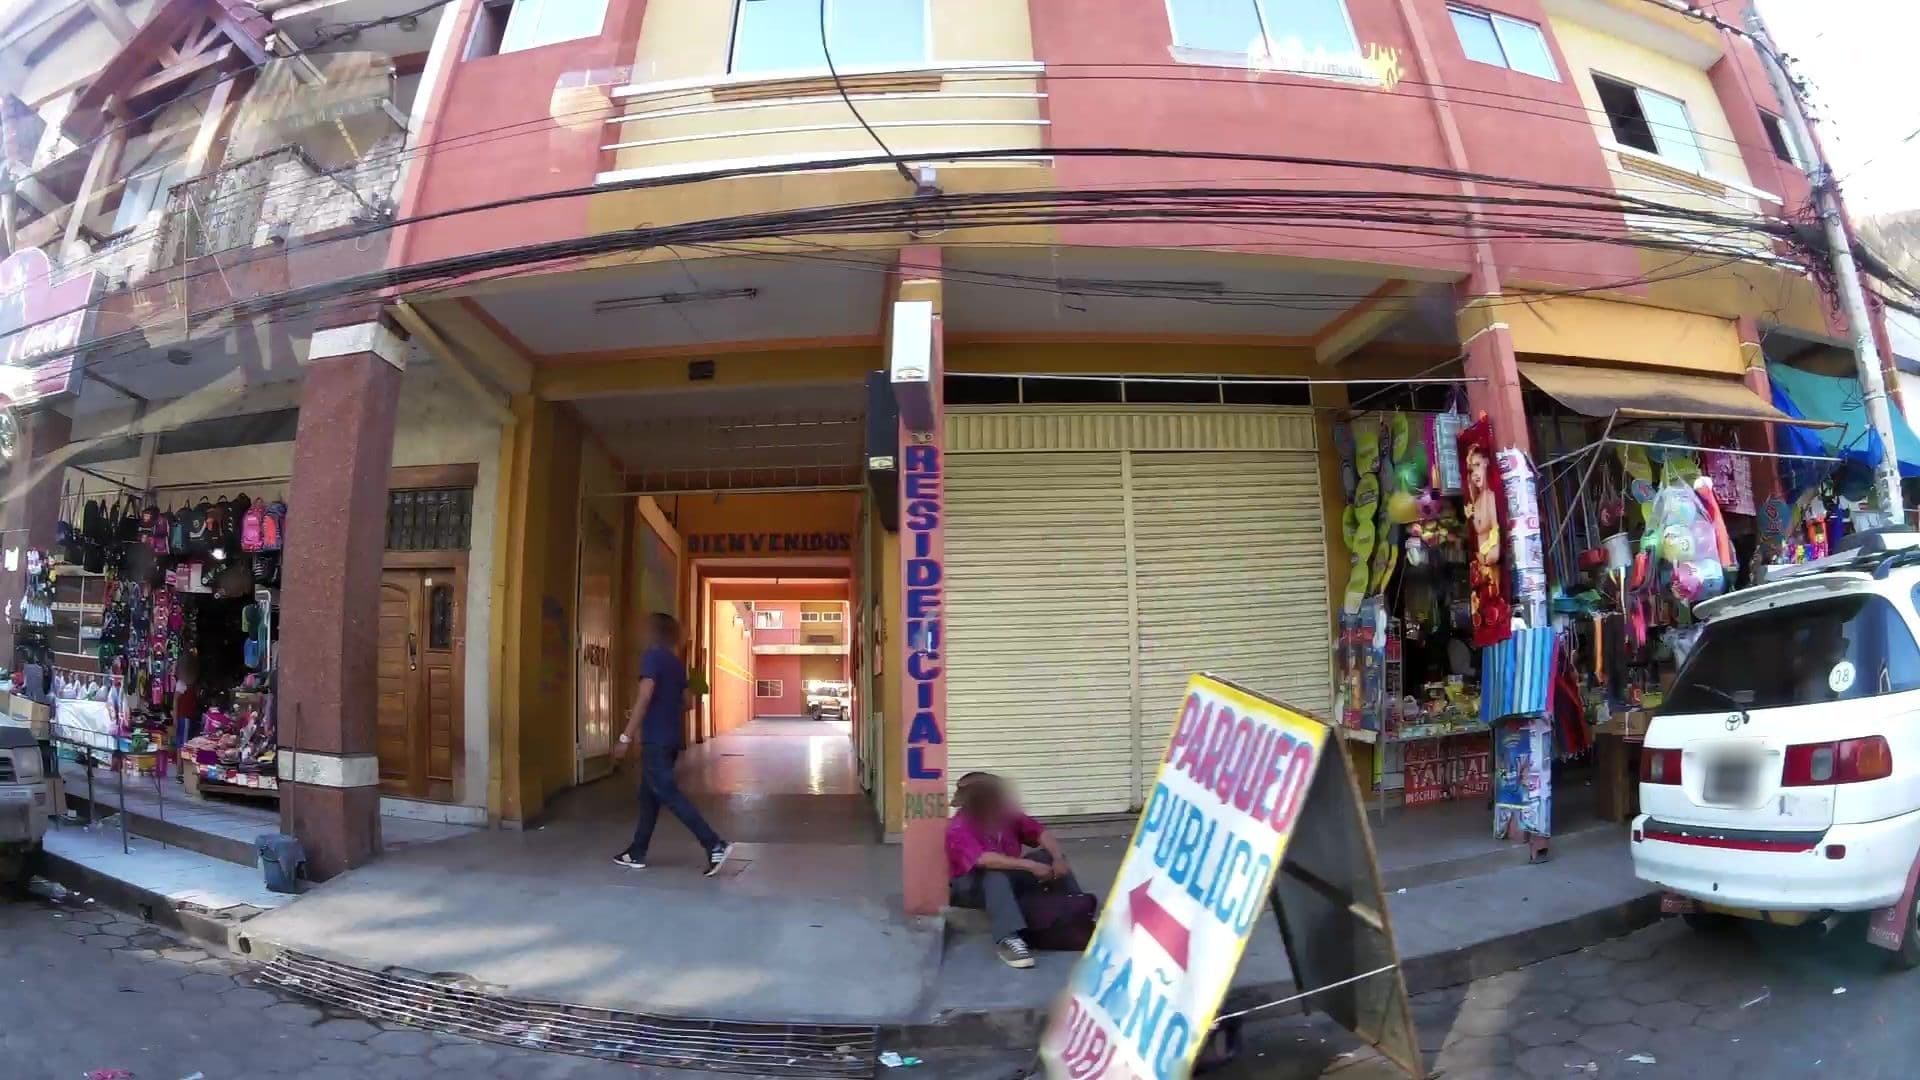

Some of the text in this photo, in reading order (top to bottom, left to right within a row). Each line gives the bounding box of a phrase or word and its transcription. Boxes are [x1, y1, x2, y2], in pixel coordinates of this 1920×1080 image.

[687, 532, 849, 552] BIENVENIDOS
[905, 445, 941, 780] RESIDENCIAL
[1165, 692, 1315, 834] PARQUEO
[1135, 782, 1273, 938] PUBLICO
